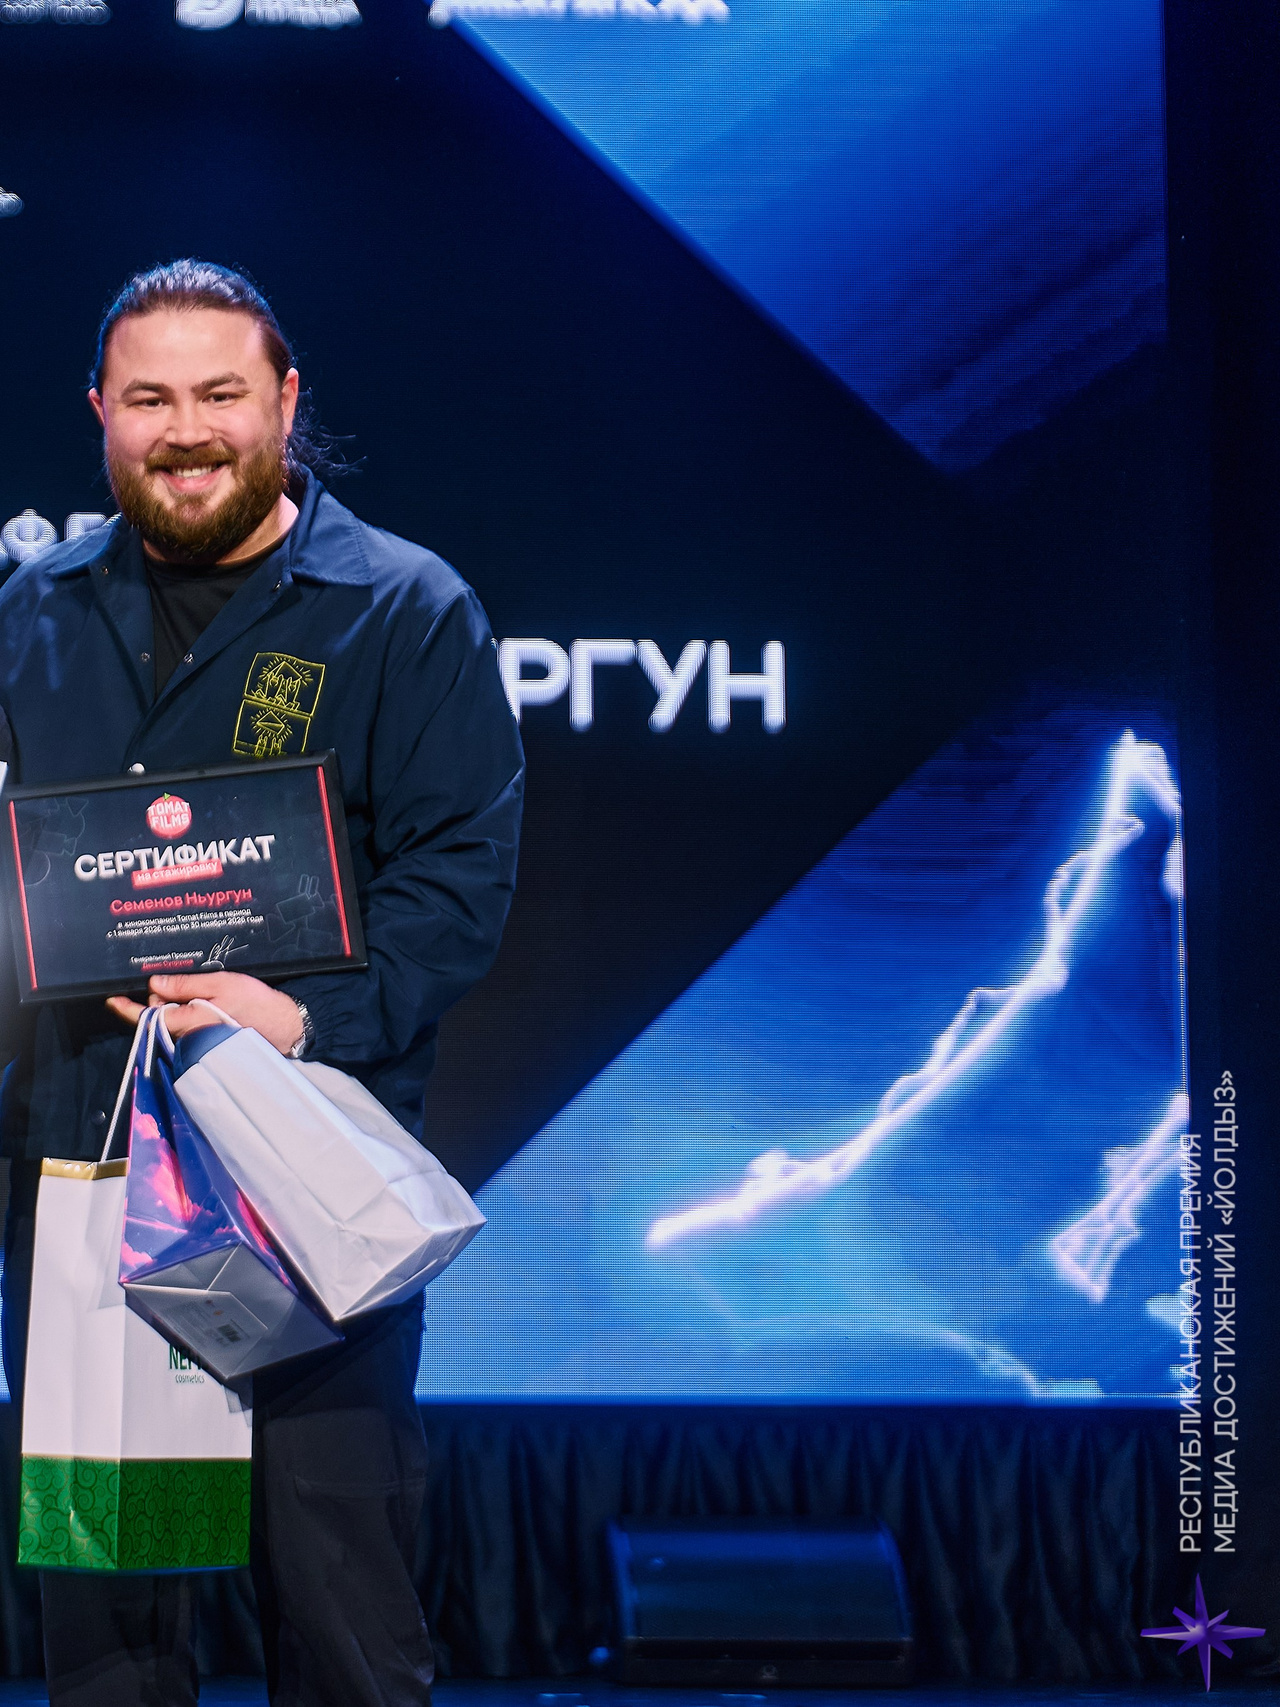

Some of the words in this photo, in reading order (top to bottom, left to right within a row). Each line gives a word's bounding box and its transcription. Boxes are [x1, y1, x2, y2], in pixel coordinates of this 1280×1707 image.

[146, 801, 190, 817] TOMAT
[151, 812, 190, 829] FILMS
[74, 834, 275, 881] СЕРТИФИКАТ
[137, 872, 151, 882] на
[153, 862, 218, 880] стажировку
[110, 894, 183, 915] Семенов
[185, 886, 253, 907] Ньургун
[177, 913, 199, 921] Tomat
[200, 911, 218, 920] Films
[224, 908, 252, 918] период
[118, 928, 143, 937] января
[143, 925, 161, 934] 2026
[162, 923, 180, 932] года
[181, 922, 190, 930] по
[191, 921, 200, 929] 30
[200, 918, 227, 928] ноября
[227, 916, 246, 926] 2026
[246, 915, 264, 924] года
[175, 1374, 205, 1384] cosmetics
